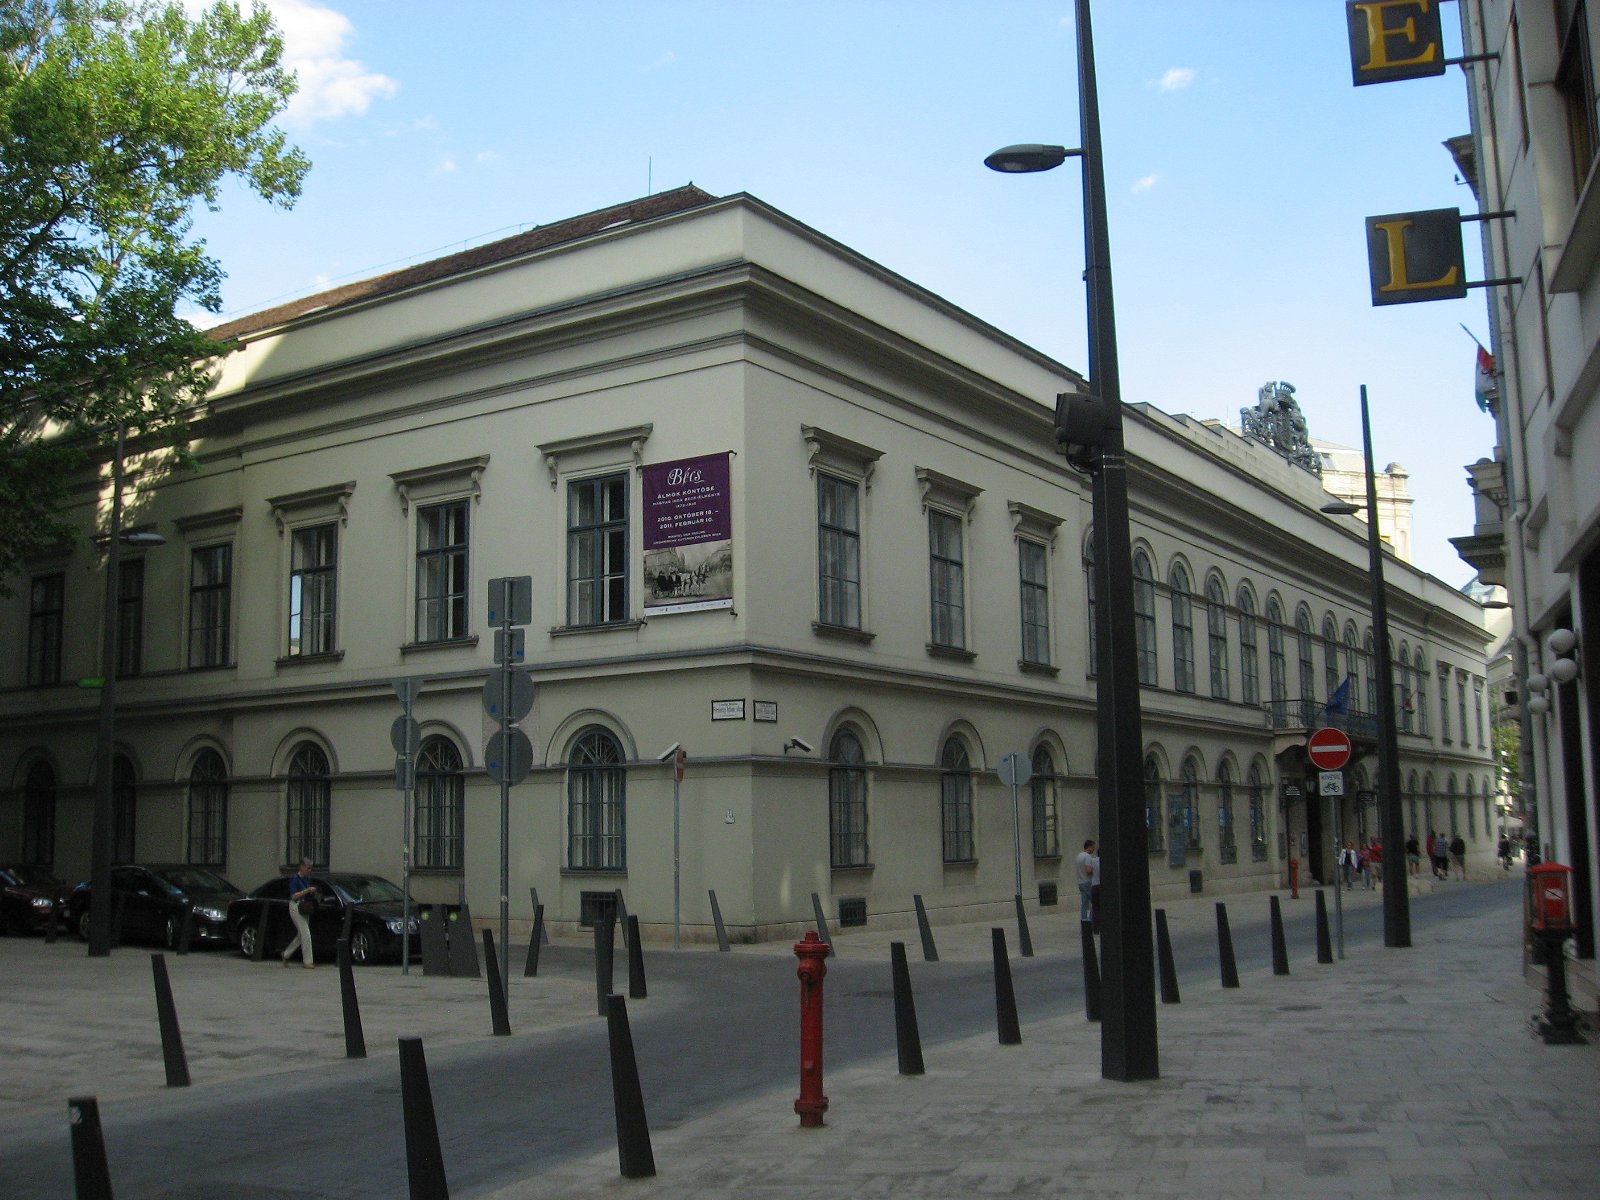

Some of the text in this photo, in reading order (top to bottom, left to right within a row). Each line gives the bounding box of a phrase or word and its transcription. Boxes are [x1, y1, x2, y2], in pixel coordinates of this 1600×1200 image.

[667, 467, 705, 486] Bécs
[674, 511, 704, 520] OKTÓBER
[675, 518, 704, 527] FEBRUÁR
